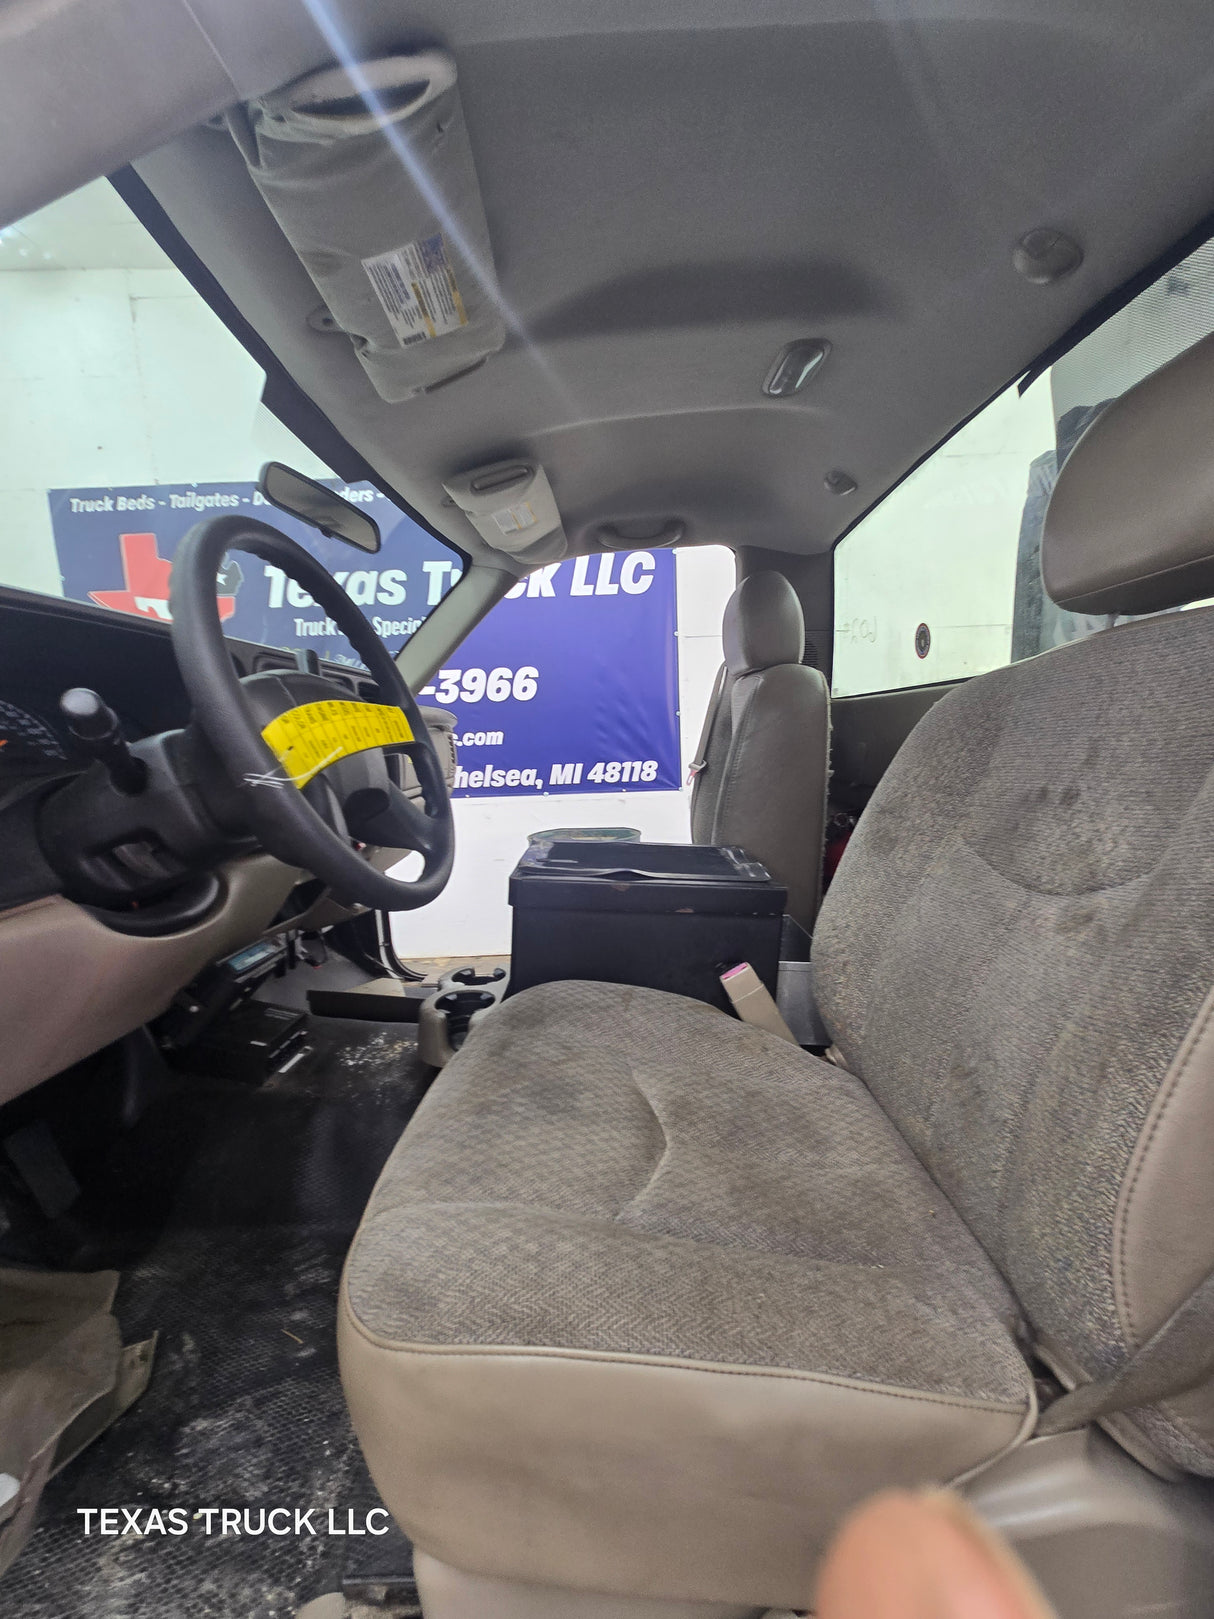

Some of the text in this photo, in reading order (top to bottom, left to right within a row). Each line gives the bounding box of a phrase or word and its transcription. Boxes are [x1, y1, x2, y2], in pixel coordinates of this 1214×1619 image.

[70, 496, 114, 513] Truck
[116, 494, 155, 511] Beds
[169, 491, 240, 512] Tailgates
[570, 551, 656, 596] LLC
[453, 760, 659, 789] helsea, MI 48118
